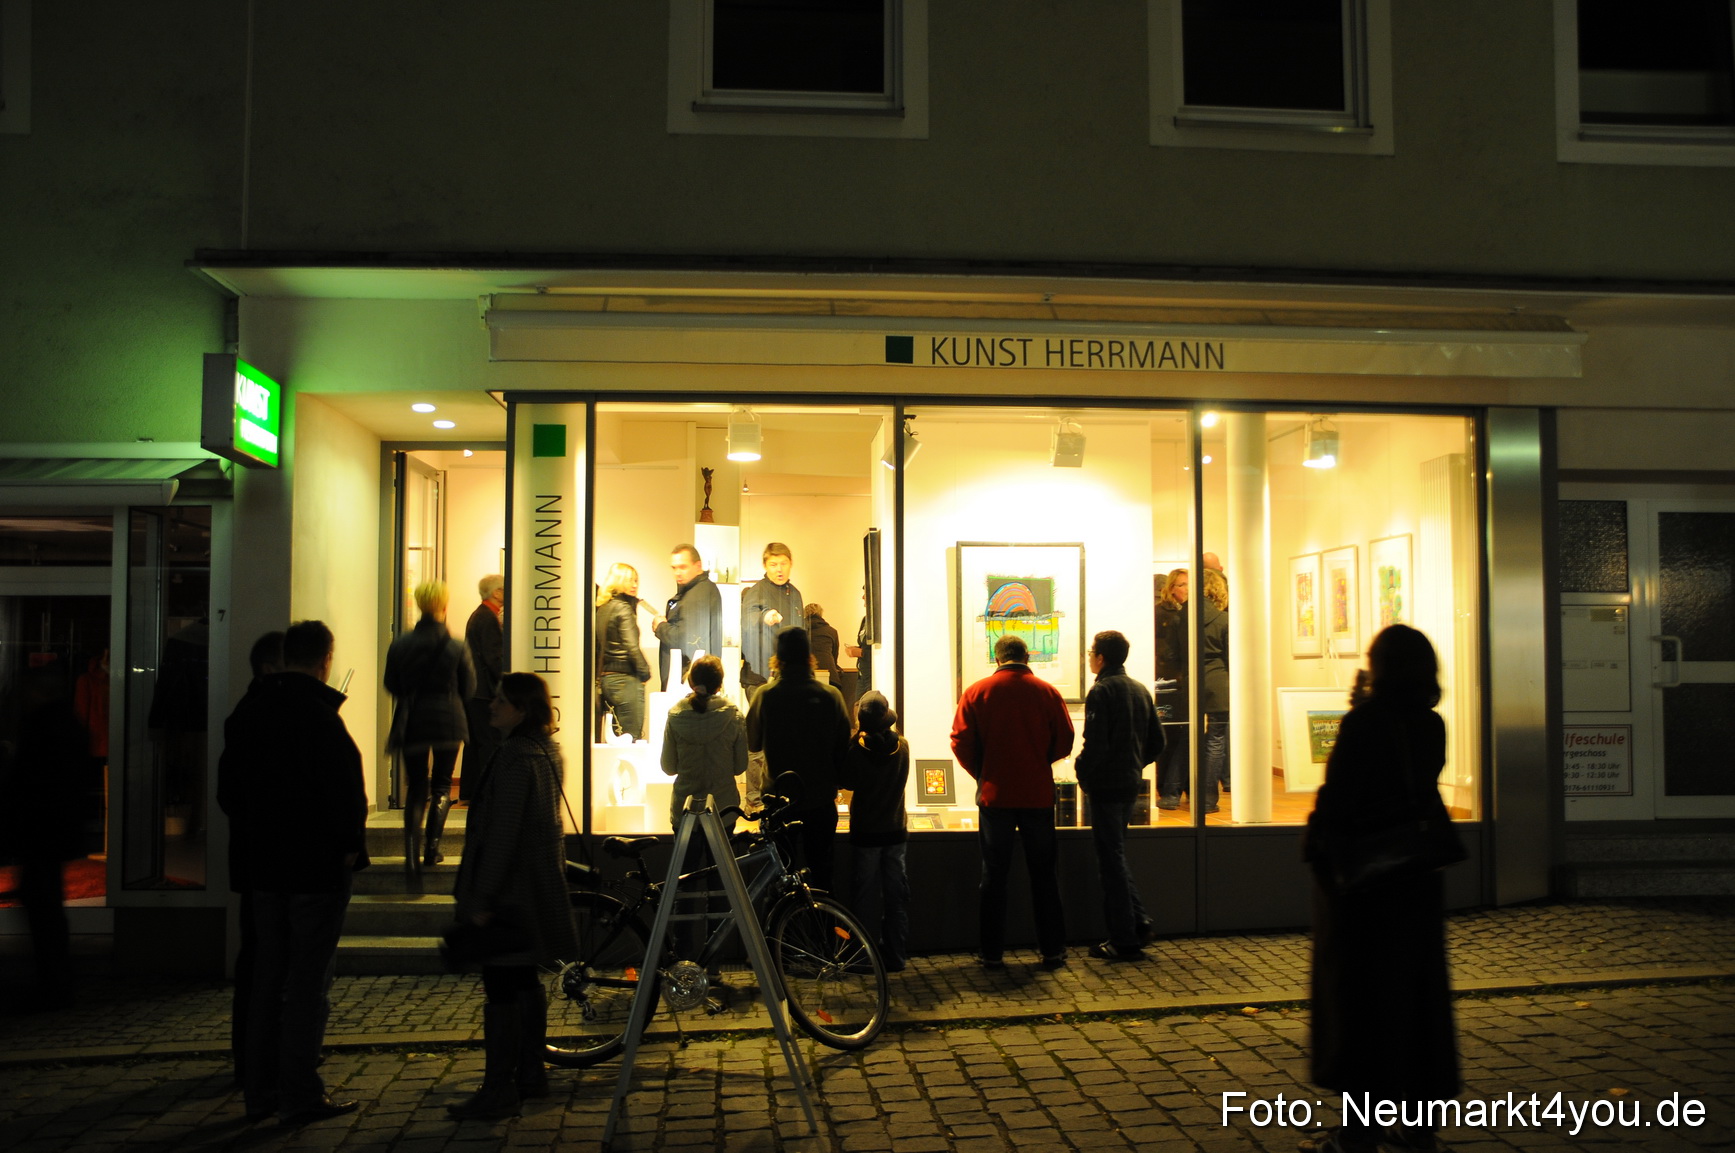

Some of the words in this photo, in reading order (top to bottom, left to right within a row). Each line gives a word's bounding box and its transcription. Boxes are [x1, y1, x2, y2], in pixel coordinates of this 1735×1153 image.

[931, 336, 1033, 367] KUNST
[1045, 338, 1225, 370] HERRMANN
[533, 495, 562, 674] HERRMANN
[1563, 732, 1625, 748] lfeschule
